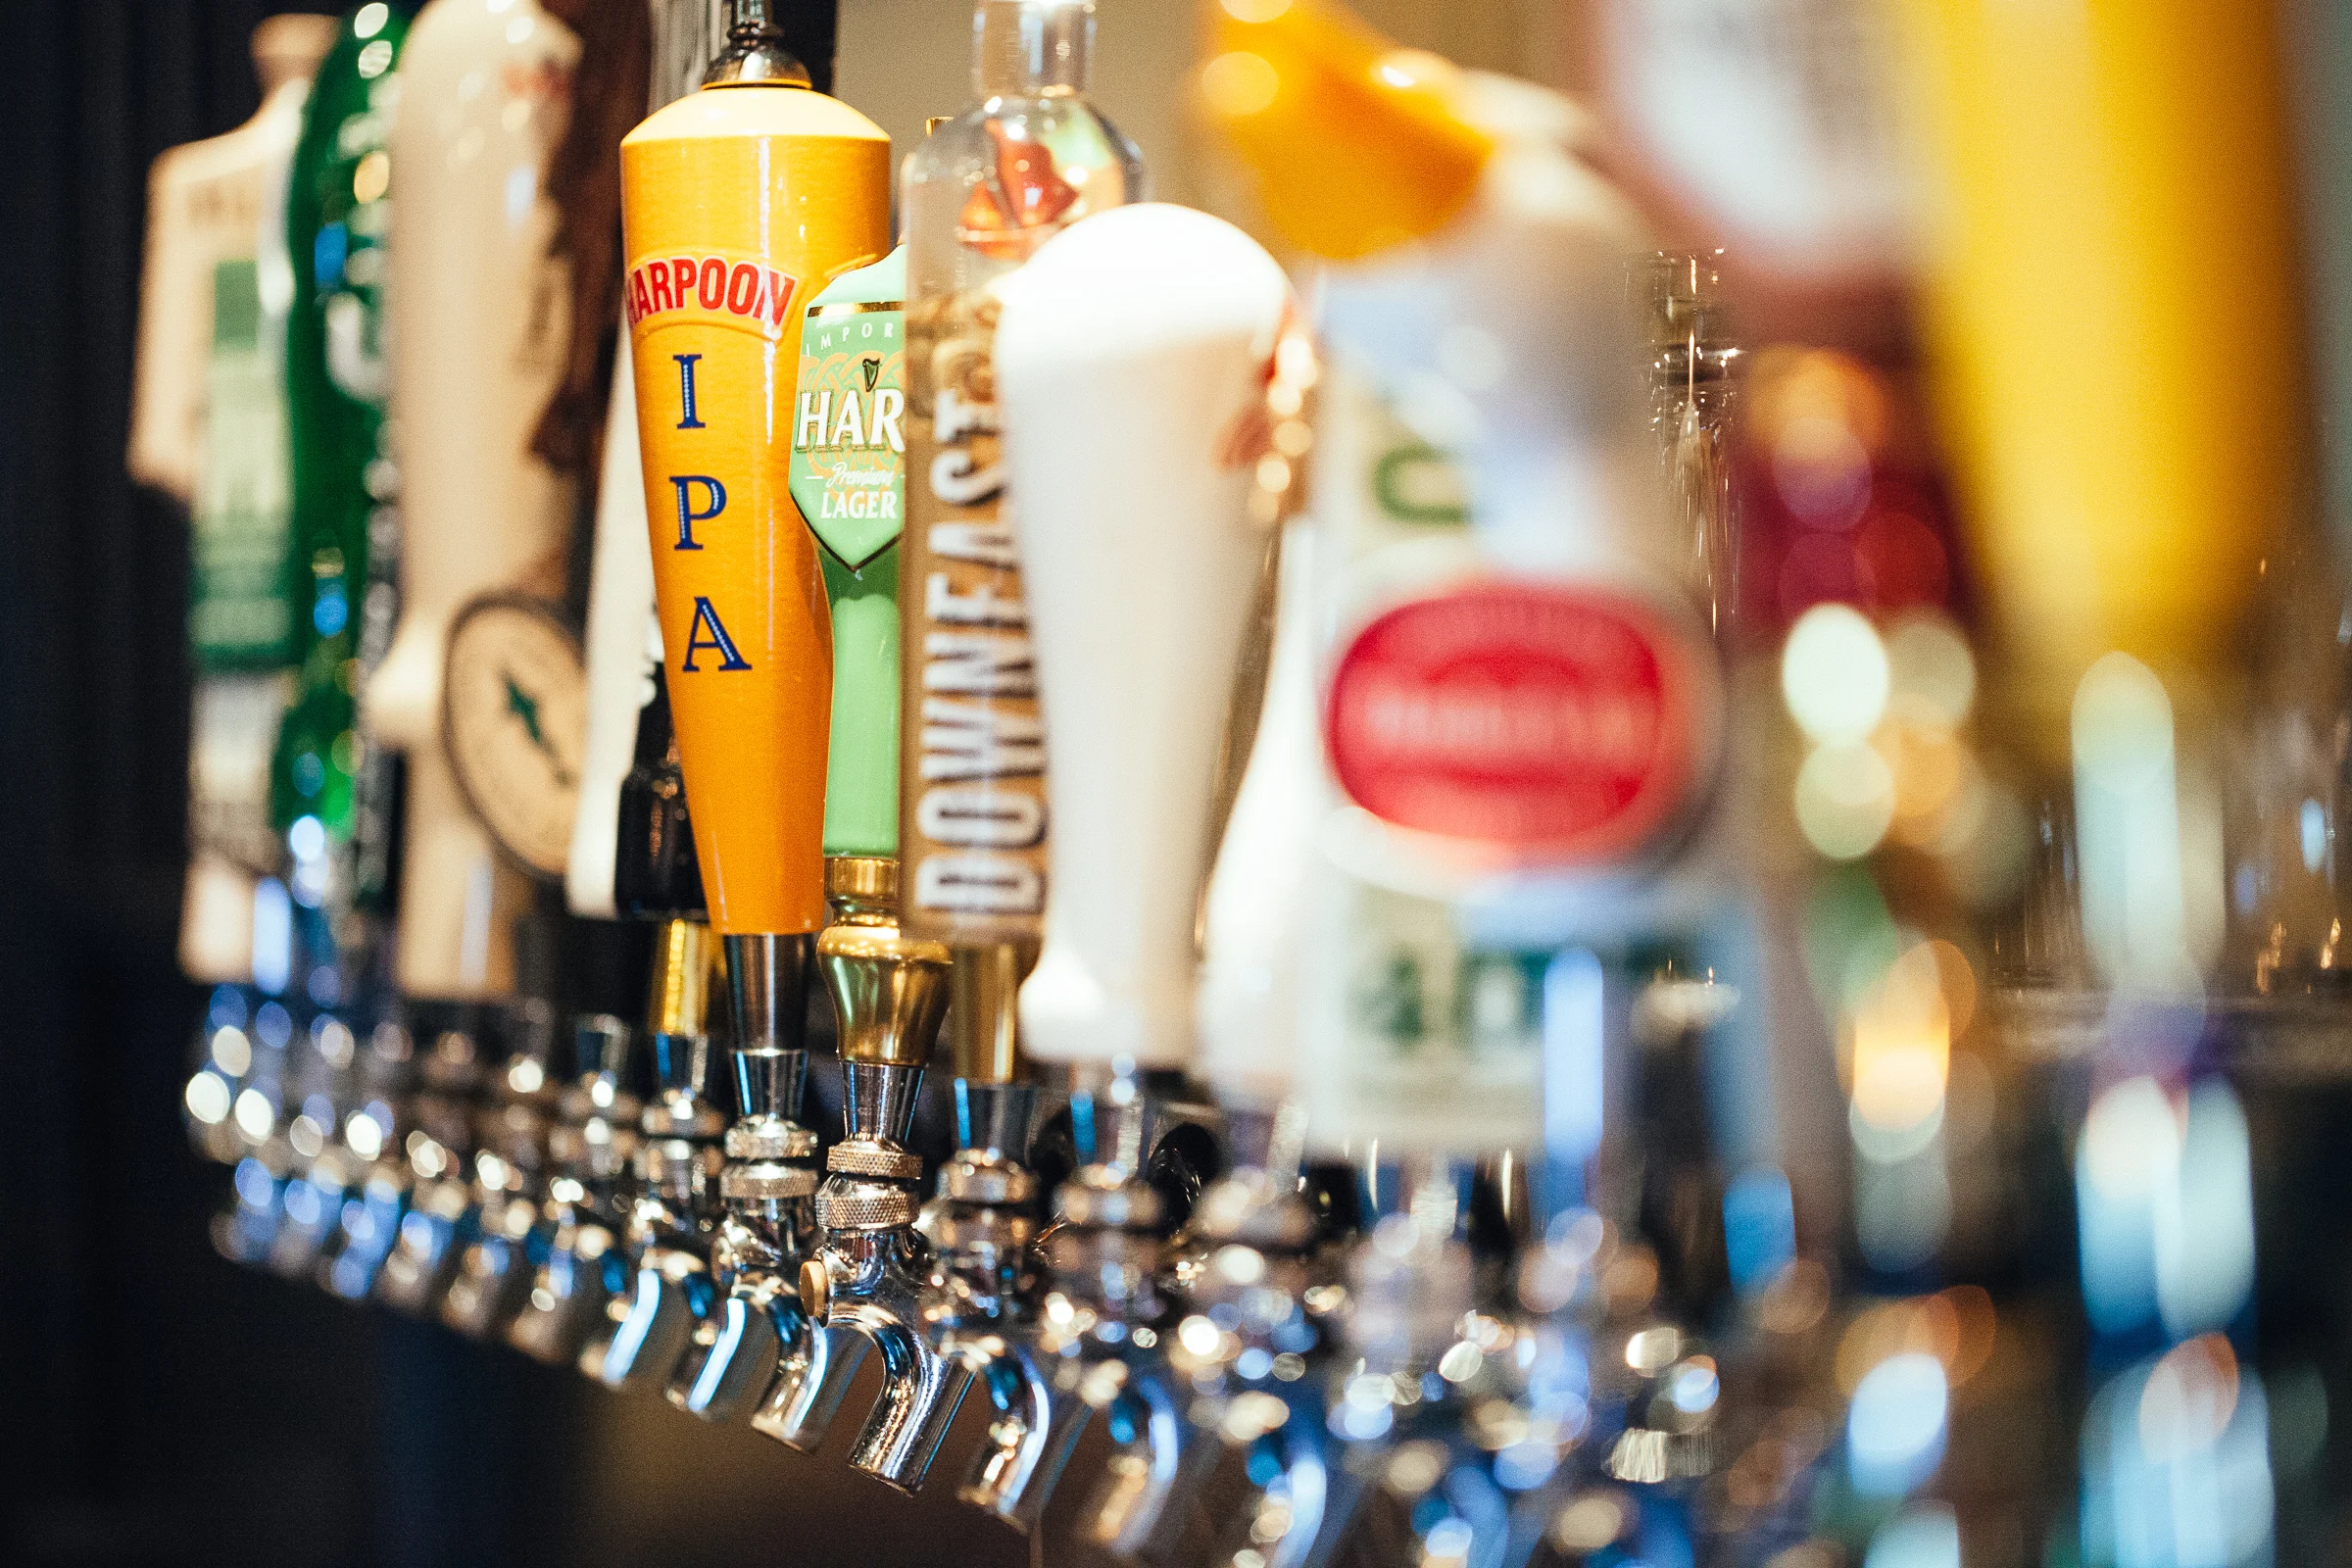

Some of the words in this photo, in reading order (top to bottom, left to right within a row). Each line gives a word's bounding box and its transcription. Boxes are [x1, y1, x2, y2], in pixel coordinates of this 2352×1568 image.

[806, 322, 894, 359] IMPOR
[796, 388, 906, 454] HAR
[820, 491, 898, 519] LAGER
